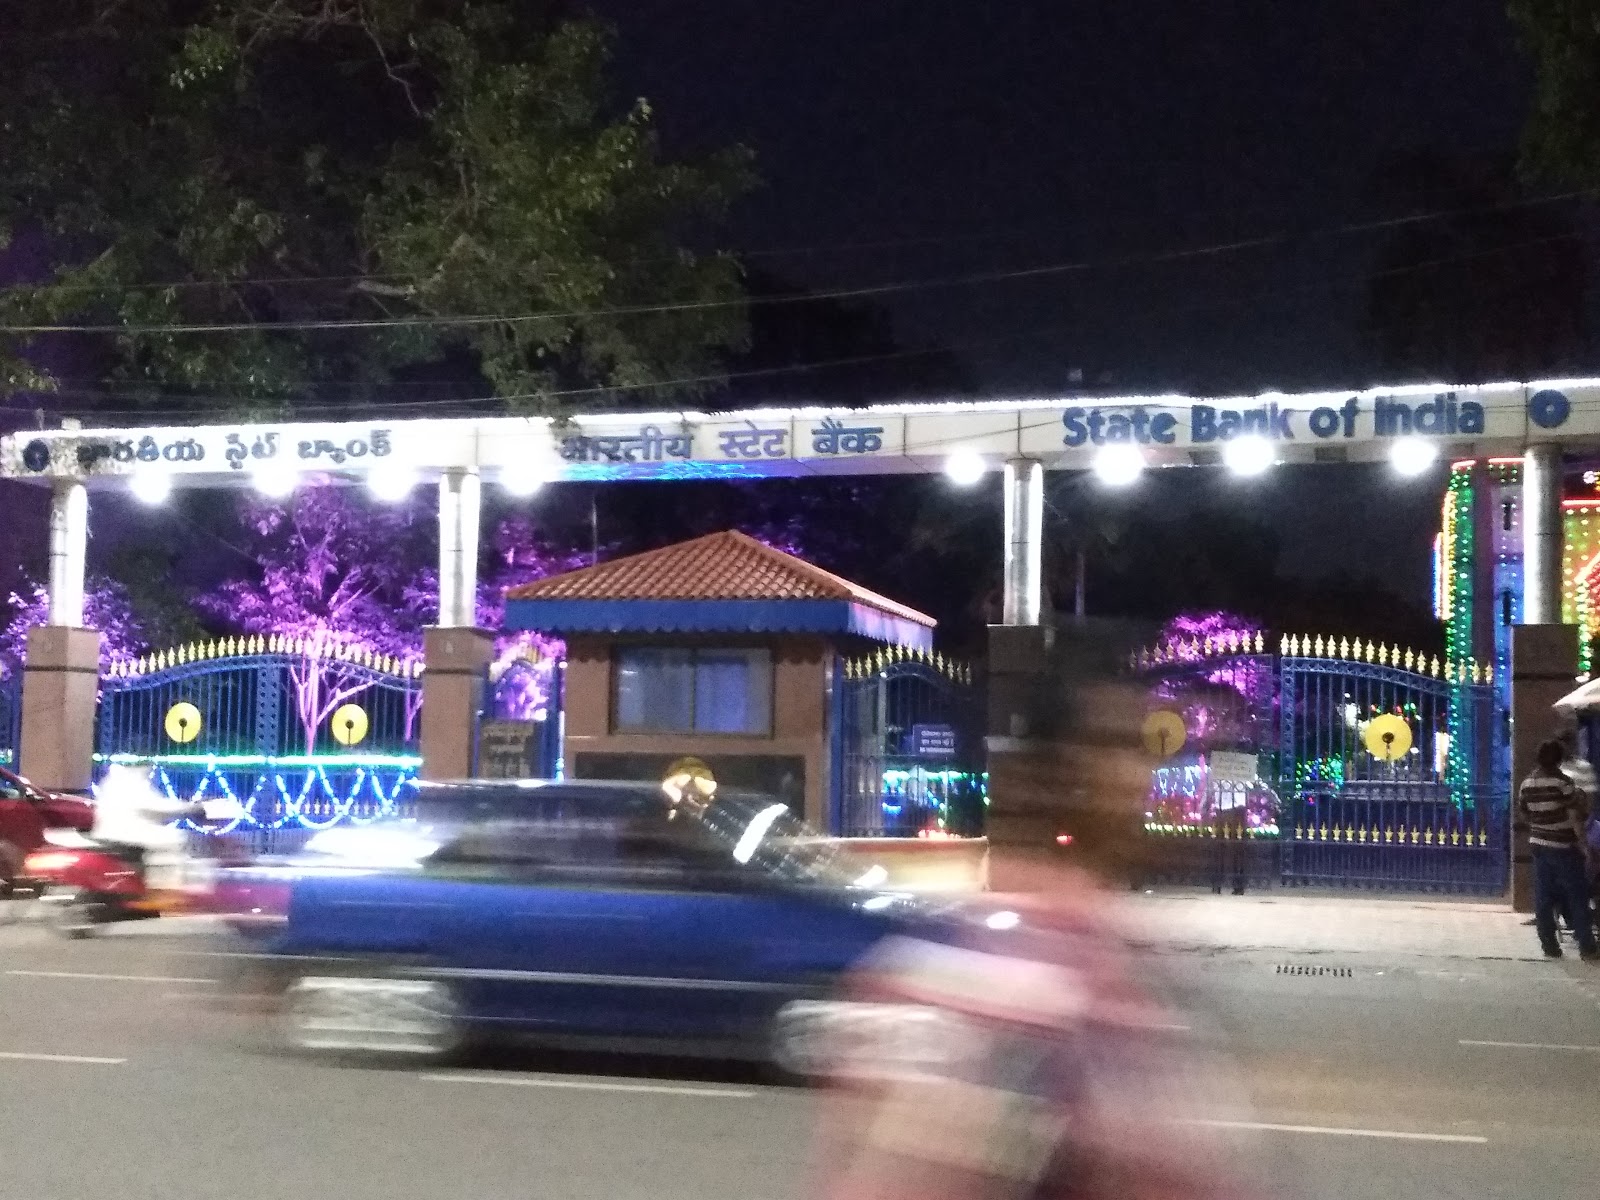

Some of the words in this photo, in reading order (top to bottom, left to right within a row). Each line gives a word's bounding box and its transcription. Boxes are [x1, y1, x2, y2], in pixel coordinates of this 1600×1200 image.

[561, 424, 694, 461] भारतीय
[719, 419, 788, 458] स्टेट
[811, 416, 884, 454] बैंक
[1063, 406, 1178, 447] State
[1191, 402, 1294, 442] Bank
[1309, 397, 1358, 438] of
[1375, 392, 1485, 436] India
